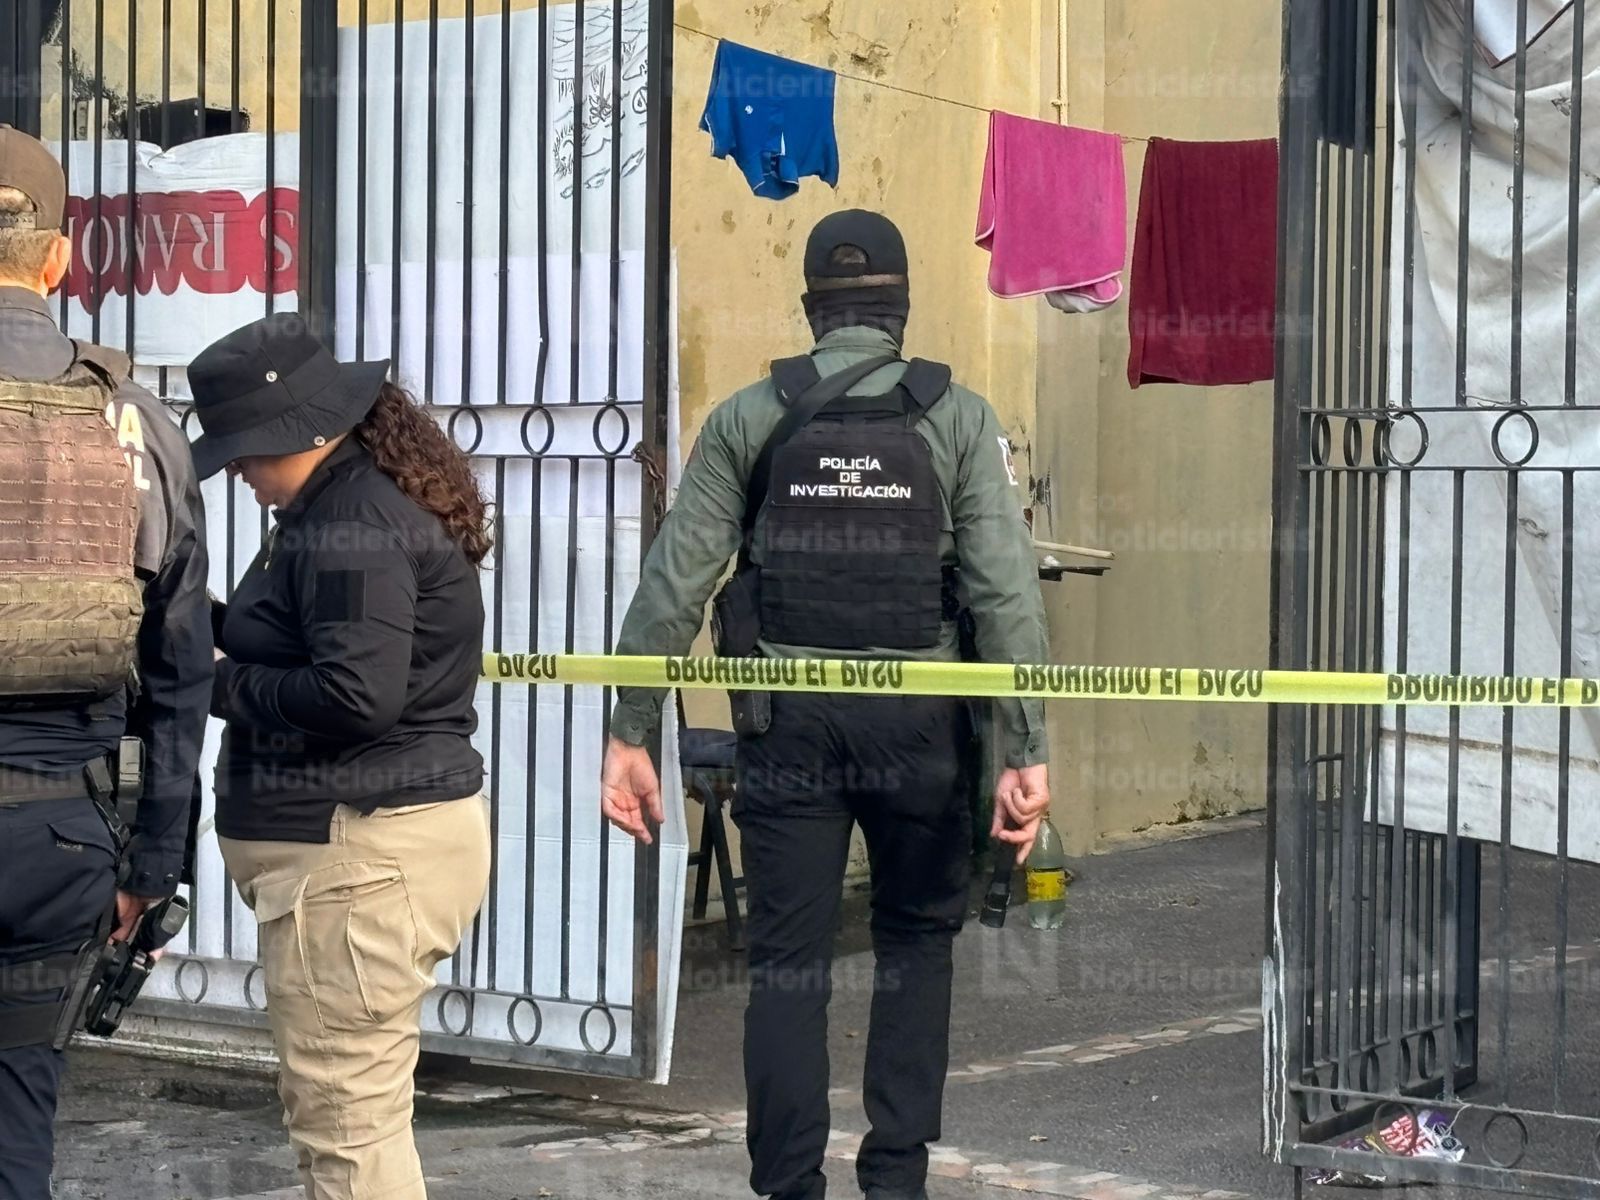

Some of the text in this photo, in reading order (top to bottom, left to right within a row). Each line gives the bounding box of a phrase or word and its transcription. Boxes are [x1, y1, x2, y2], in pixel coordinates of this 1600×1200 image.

[68, 209, 294, 277] S RAMO
[819, 456, 882, 471] POLICÍA
[840, 472, 861, 483] DE
[790, 483, 911, 499] INVESTIGACIÓN
